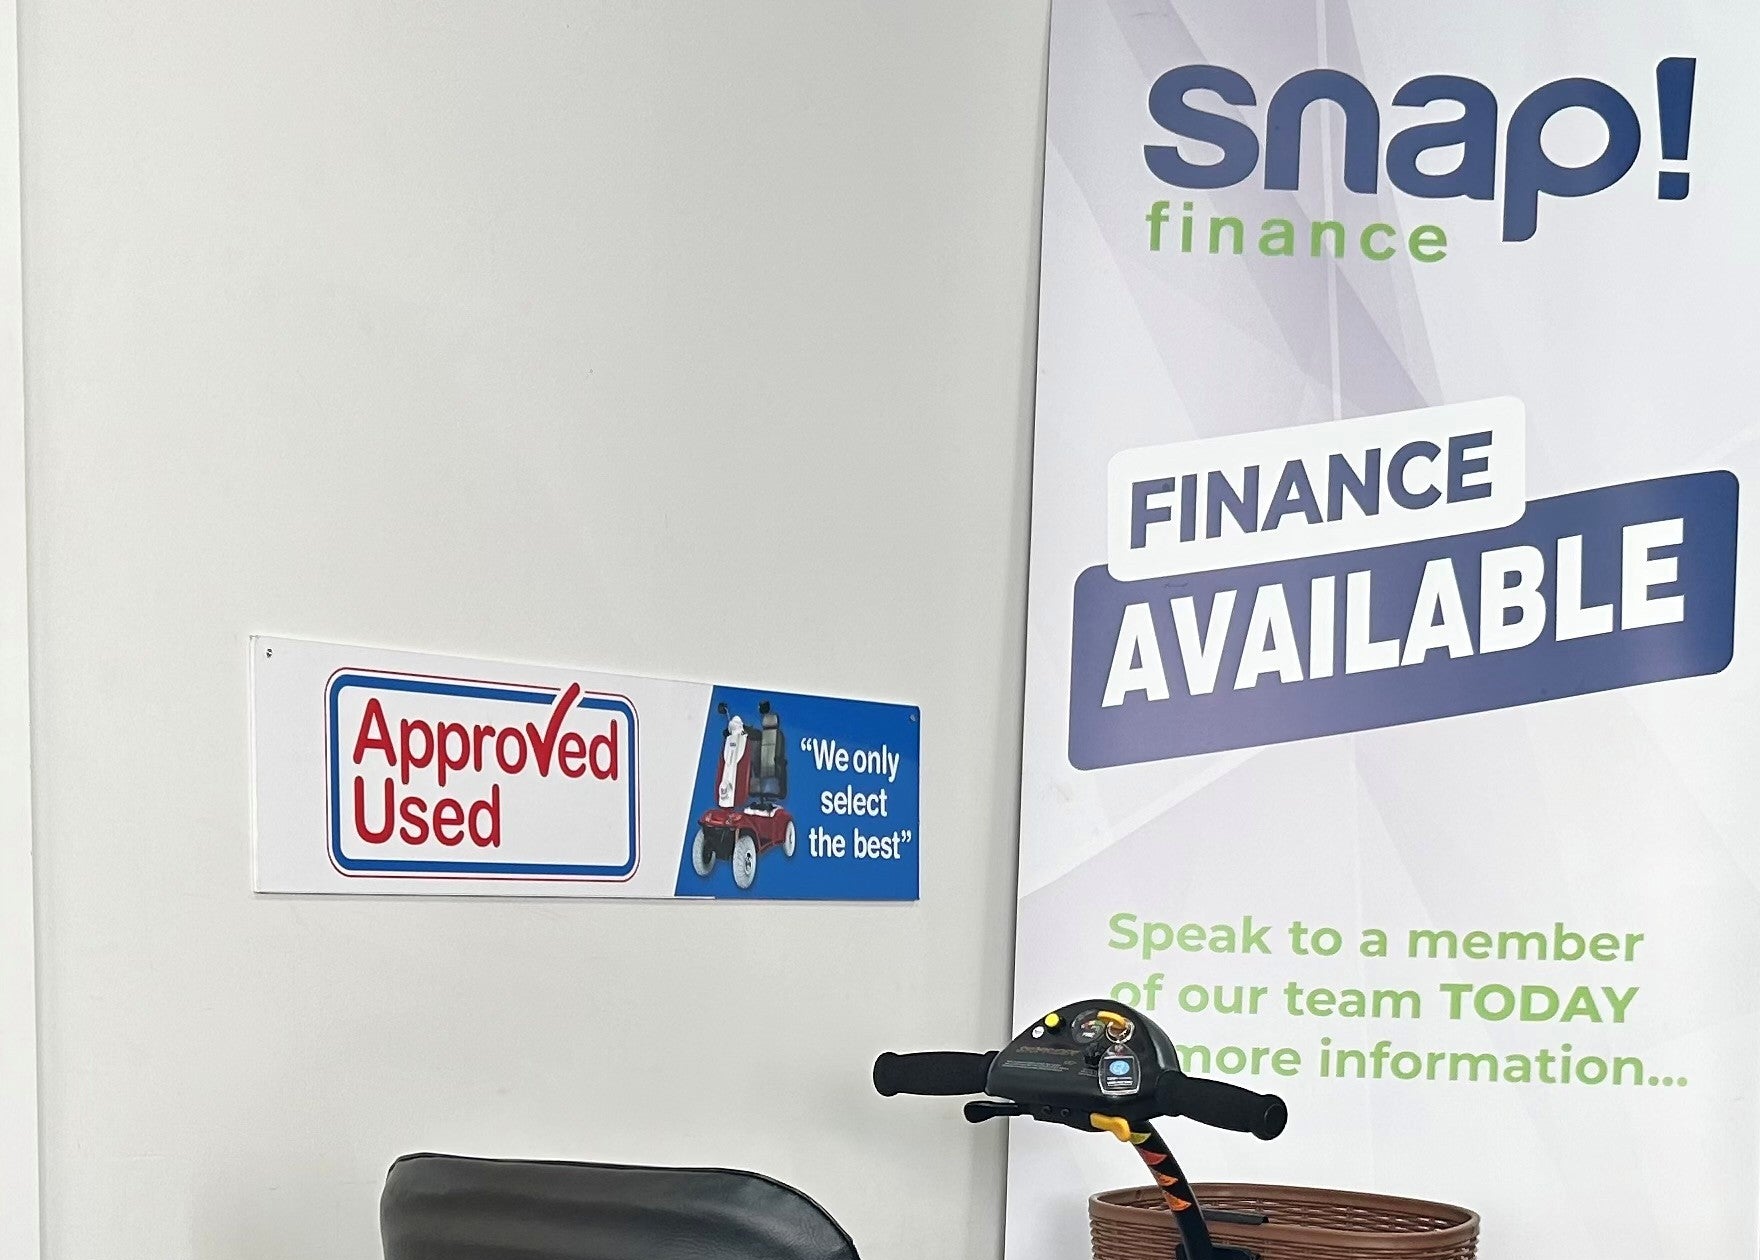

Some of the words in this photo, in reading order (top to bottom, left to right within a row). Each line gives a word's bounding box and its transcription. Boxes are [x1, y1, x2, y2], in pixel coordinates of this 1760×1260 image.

[1143, 57, 1697, 242] snap!
[1145, 201, 1449, 263] finance
[1130, 430, 1493, 550] FINANCE
[1102, 517, 1685, 708] AVAILABLE
[353, 682, 619, 787] Approved
[853, 744, 900, 783] only
[353, 776, 501, 849] Used
[820, 785, 888, 817] select
[808, 826, 846, 859] the
[1108, 912, 1272, 960] Speak
[1288, 921, 1343, 956] to
[1359, 928, 1388, 957] a
[1408, 922, 1644, 962] member
[1110, 972, 1165, 1011] of
[1178, 983, 1268, 1015] our
[1283, 981, 1421, 1019] team
[1439, 983, 1640, 1023] TODAY
[1176, 1044, 1302, 1077] more
[1320, 1036, 1688, 1087] information...
